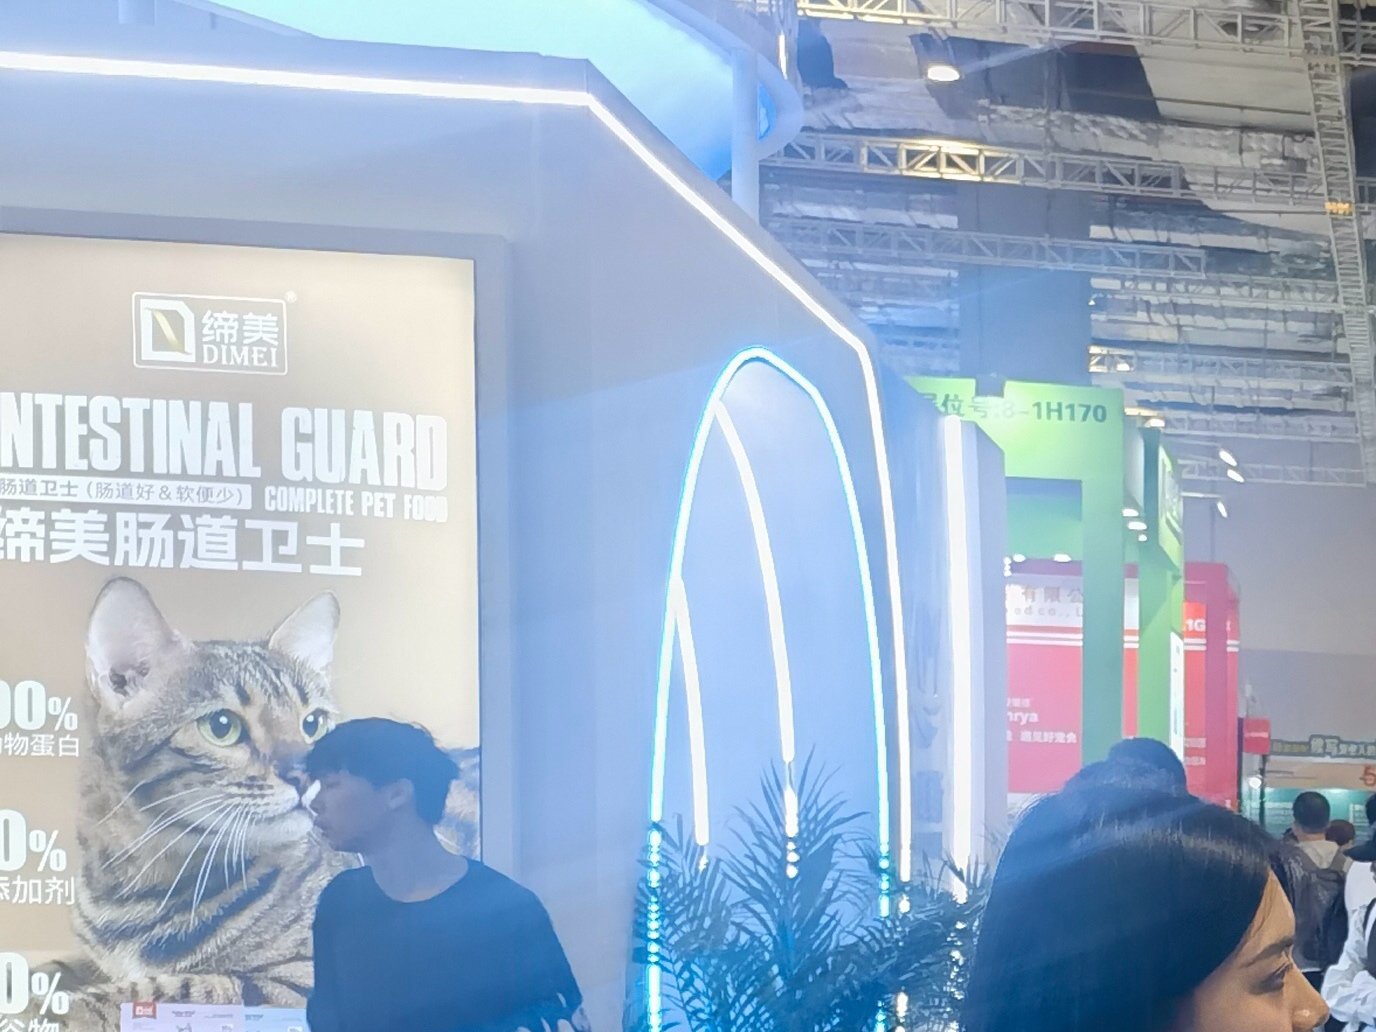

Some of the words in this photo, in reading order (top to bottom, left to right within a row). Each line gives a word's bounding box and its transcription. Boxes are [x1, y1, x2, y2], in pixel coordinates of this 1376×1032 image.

[202, 310, 280, 346] 缔美
[202, 344, 280, 369] DIMEI
[281, 406, 448, 491] GUARD
[264, 485, 354, 516] COMPLETE
[361, 492, 395, 519] PET
[404, 495, 448, 523] FOOD
[0, 506, 366, 577] 缔美肠道卫士
[0, 732, 80, 758] 物蛋白
